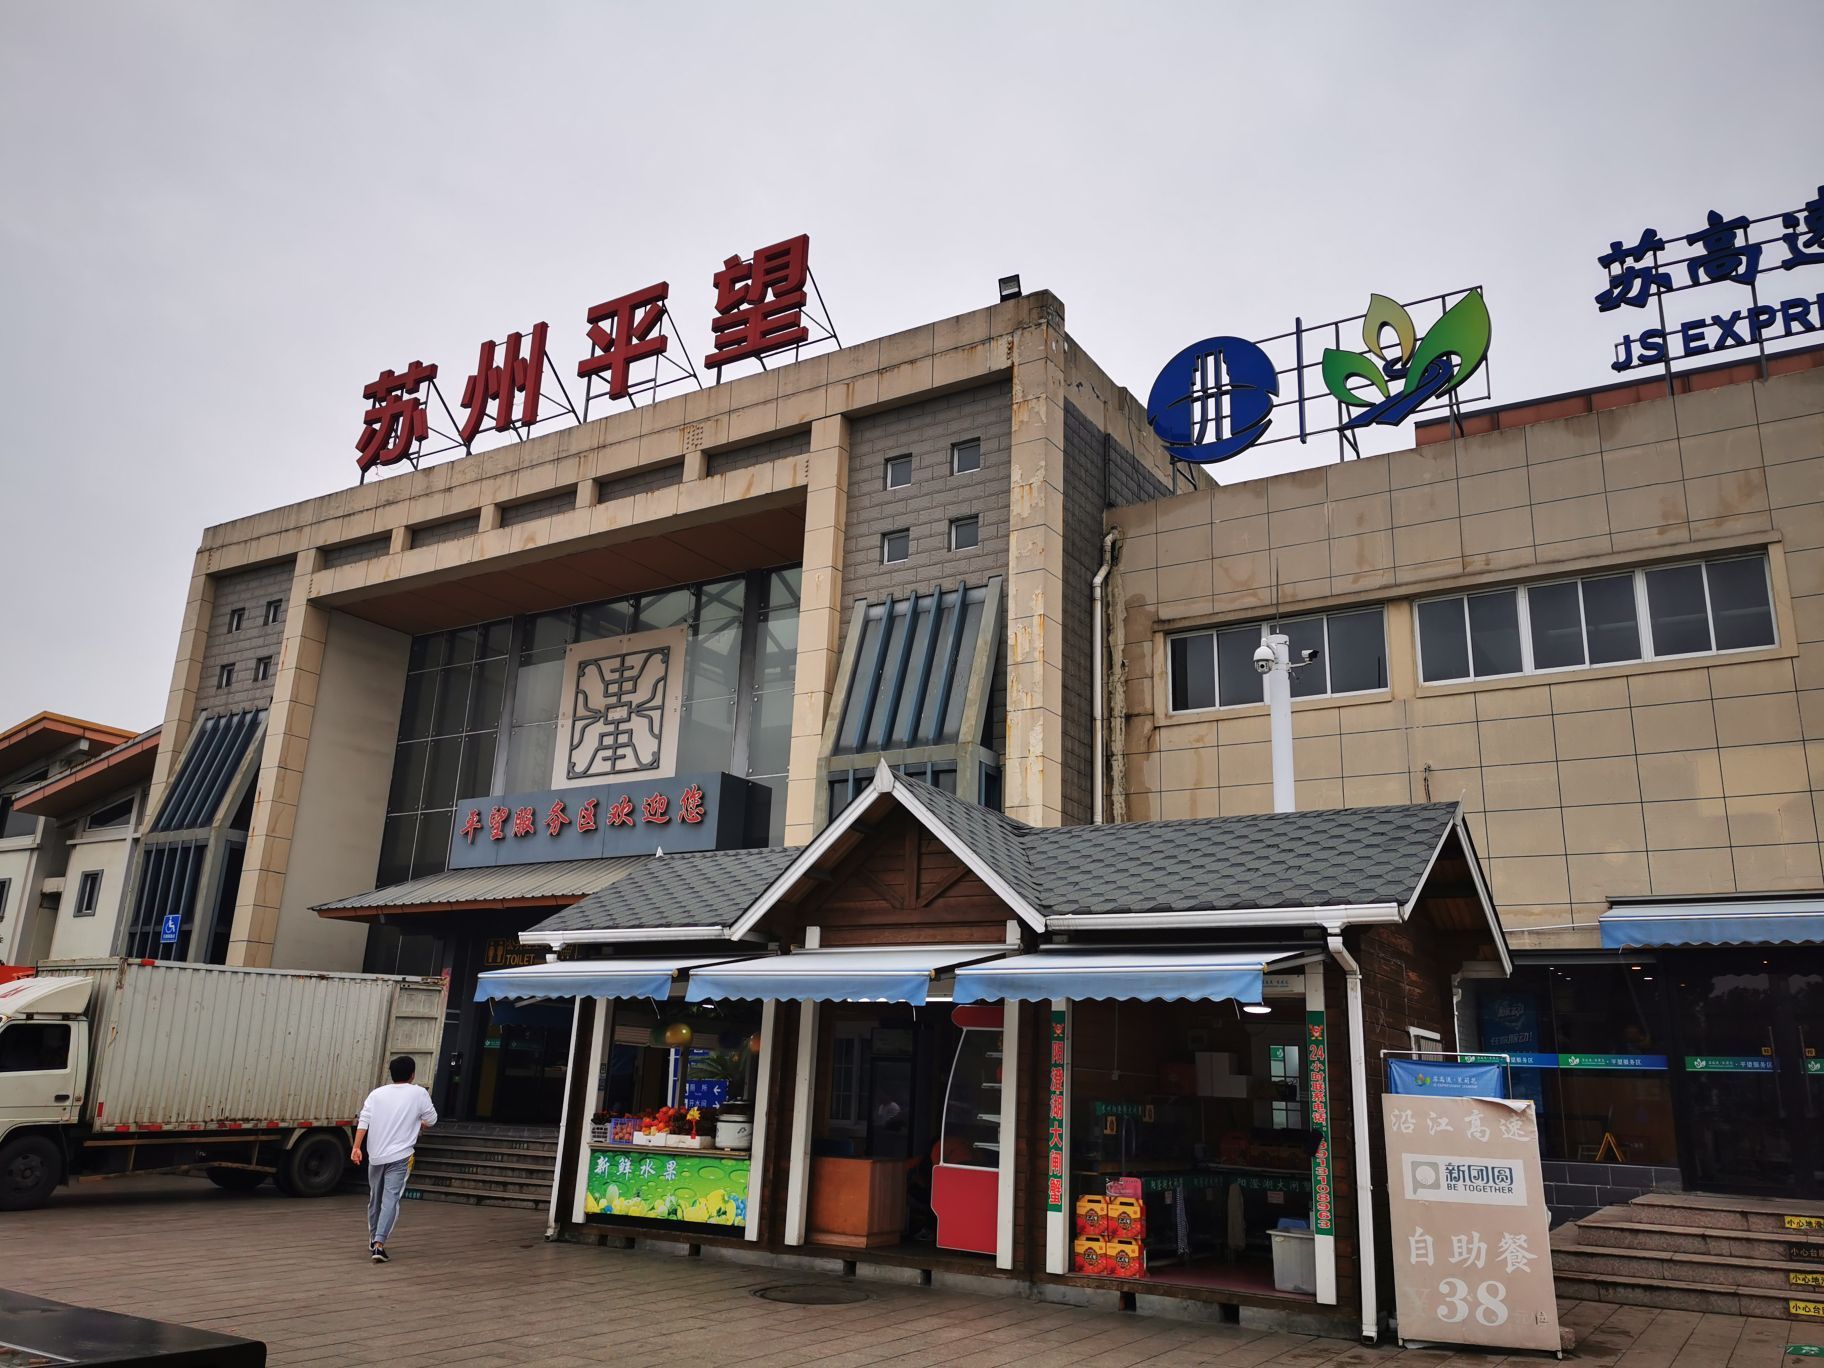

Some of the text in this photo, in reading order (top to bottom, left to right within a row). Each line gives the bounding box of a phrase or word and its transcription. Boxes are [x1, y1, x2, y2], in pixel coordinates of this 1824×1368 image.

[355, 233, 810, 472] 苏州平望
[1611, 292, 1824, 373] JS EXPR
[460, 784, 705, 845] 平望服务区欢迎您
[505, 953, 536, 966] TOILET
[1048, 1040, 1065, 1206] 阳澄湖大闸蟹
[1390, 1108, 1531, 1143] 沿江高速
[594, 1155, 678, 1181] 新鲜水果
[1445, 1161, 1514, 1186] 新团圆
[1447, 1183, 1513, 1194] BE TOGETHER
[1408, 1225, 1538, 1275] 自助餐
[1436, 1277, 1509, 1327] 38
[1792, 1303, 1824, 1315] 小心台
